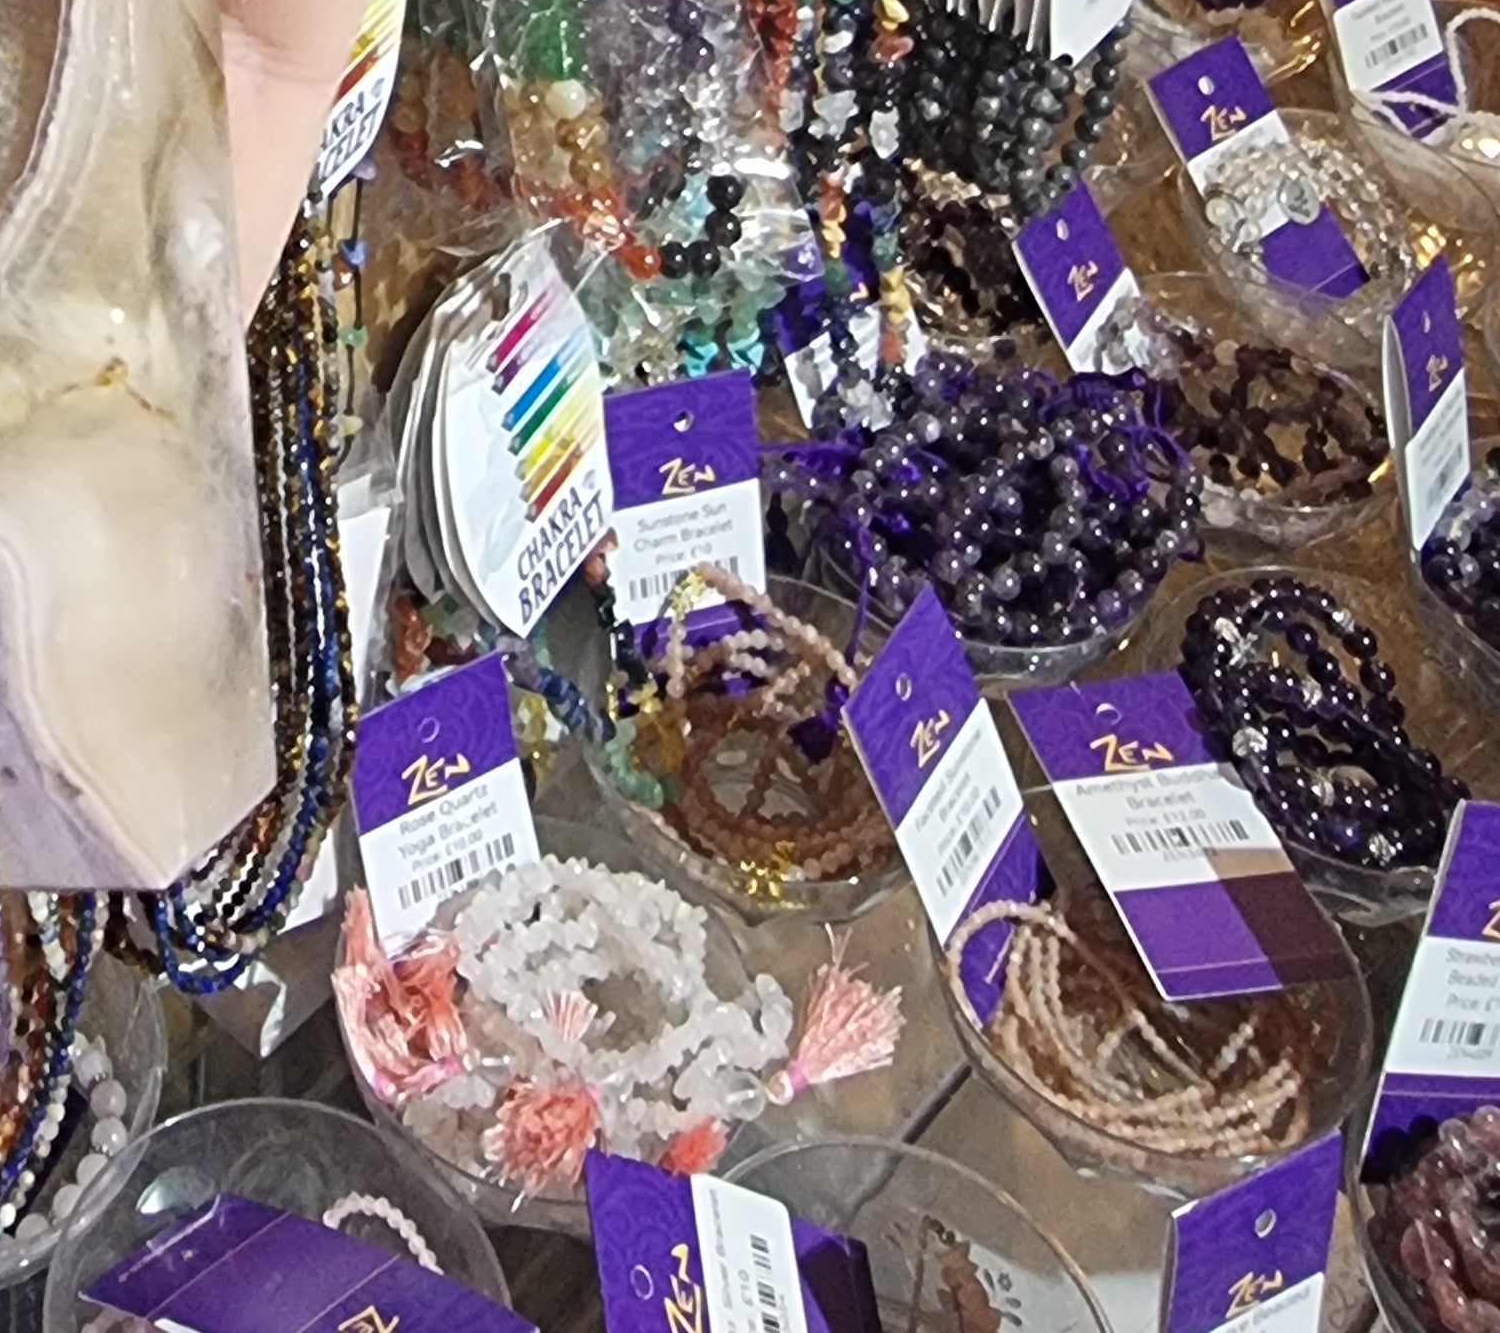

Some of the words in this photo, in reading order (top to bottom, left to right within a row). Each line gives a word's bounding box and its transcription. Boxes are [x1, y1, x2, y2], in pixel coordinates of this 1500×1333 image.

[1201, 104, 1248, 141] ZEN
[1067, 259, 1100, 302] ZEN
[659, 457, 716, 495] ZEN
[518, 486, 583, 582] CHAKRA
[518, 489, 605, 627] BRACELET
[910, 708, 950, 769] ZEN
[1089, 733, 1174, 771] ZEN
[401, 753, 471, 806] ZEN
[1076, 775, 1154, 796] Amethyst
[1126, 790, 1196, 811] Bracelet
[398, 834, 436, 859] Yoga
[438, 801, 498, 841] Bracelet
[400, 810, 436, 836] Rose
[439, 784, 488, 816] Quartz
[1225, 1269, 1284, 1318] ZEN
